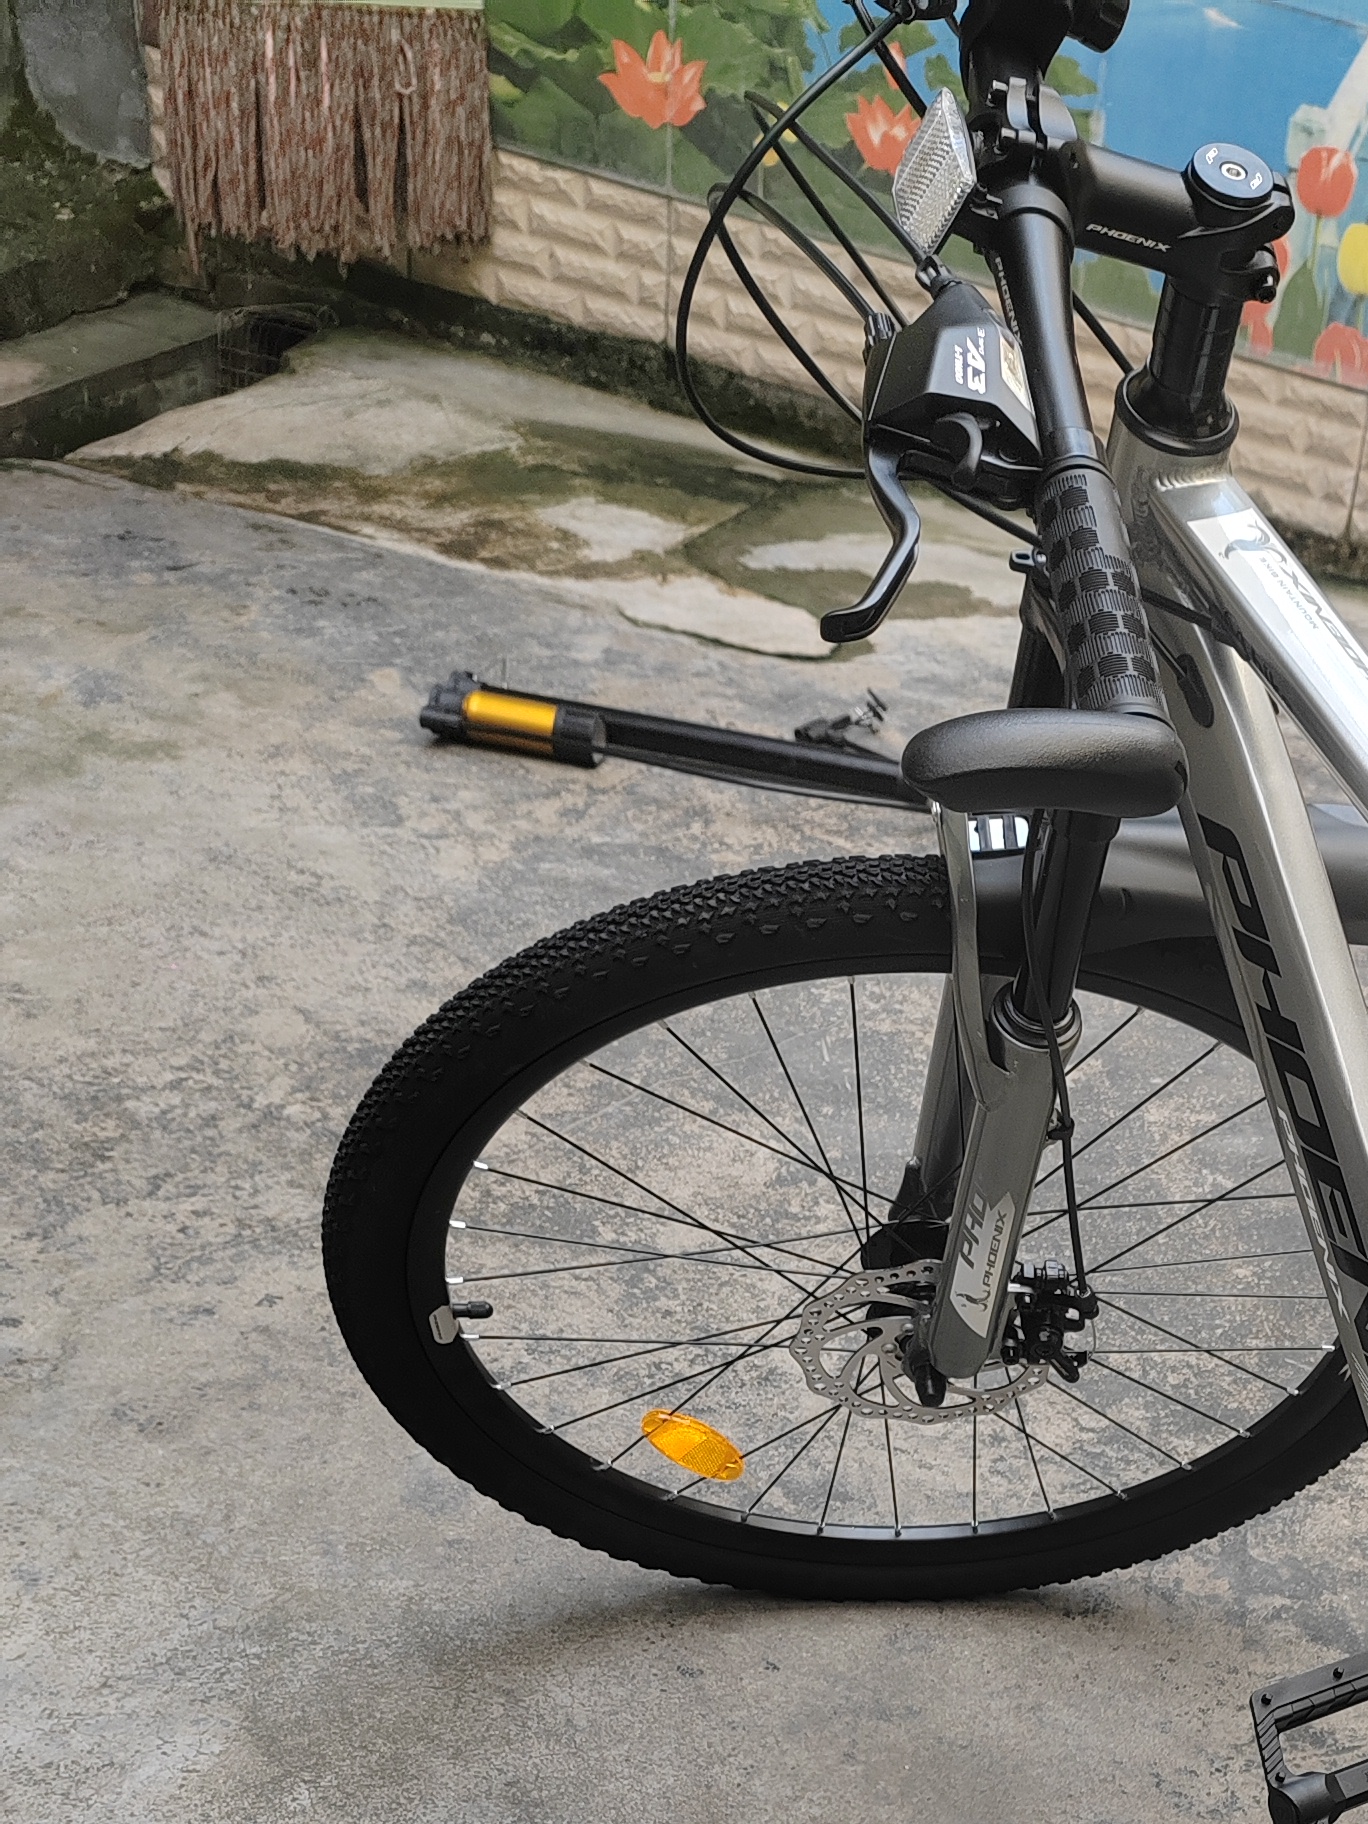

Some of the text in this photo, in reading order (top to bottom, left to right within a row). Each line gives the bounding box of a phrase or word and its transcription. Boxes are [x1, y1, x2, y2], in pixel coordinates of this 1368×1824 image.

[1086, 223, 1172, 252] PHOENIX
[994, 256, 1023, 346] PHOENIX
[1259, 556, 1319, 630] MOUNTAIN BIKE
[983, 1209, 1007, 1288] PHOENIX
[1278, 1106, 1350, 1324] PHOENIX
